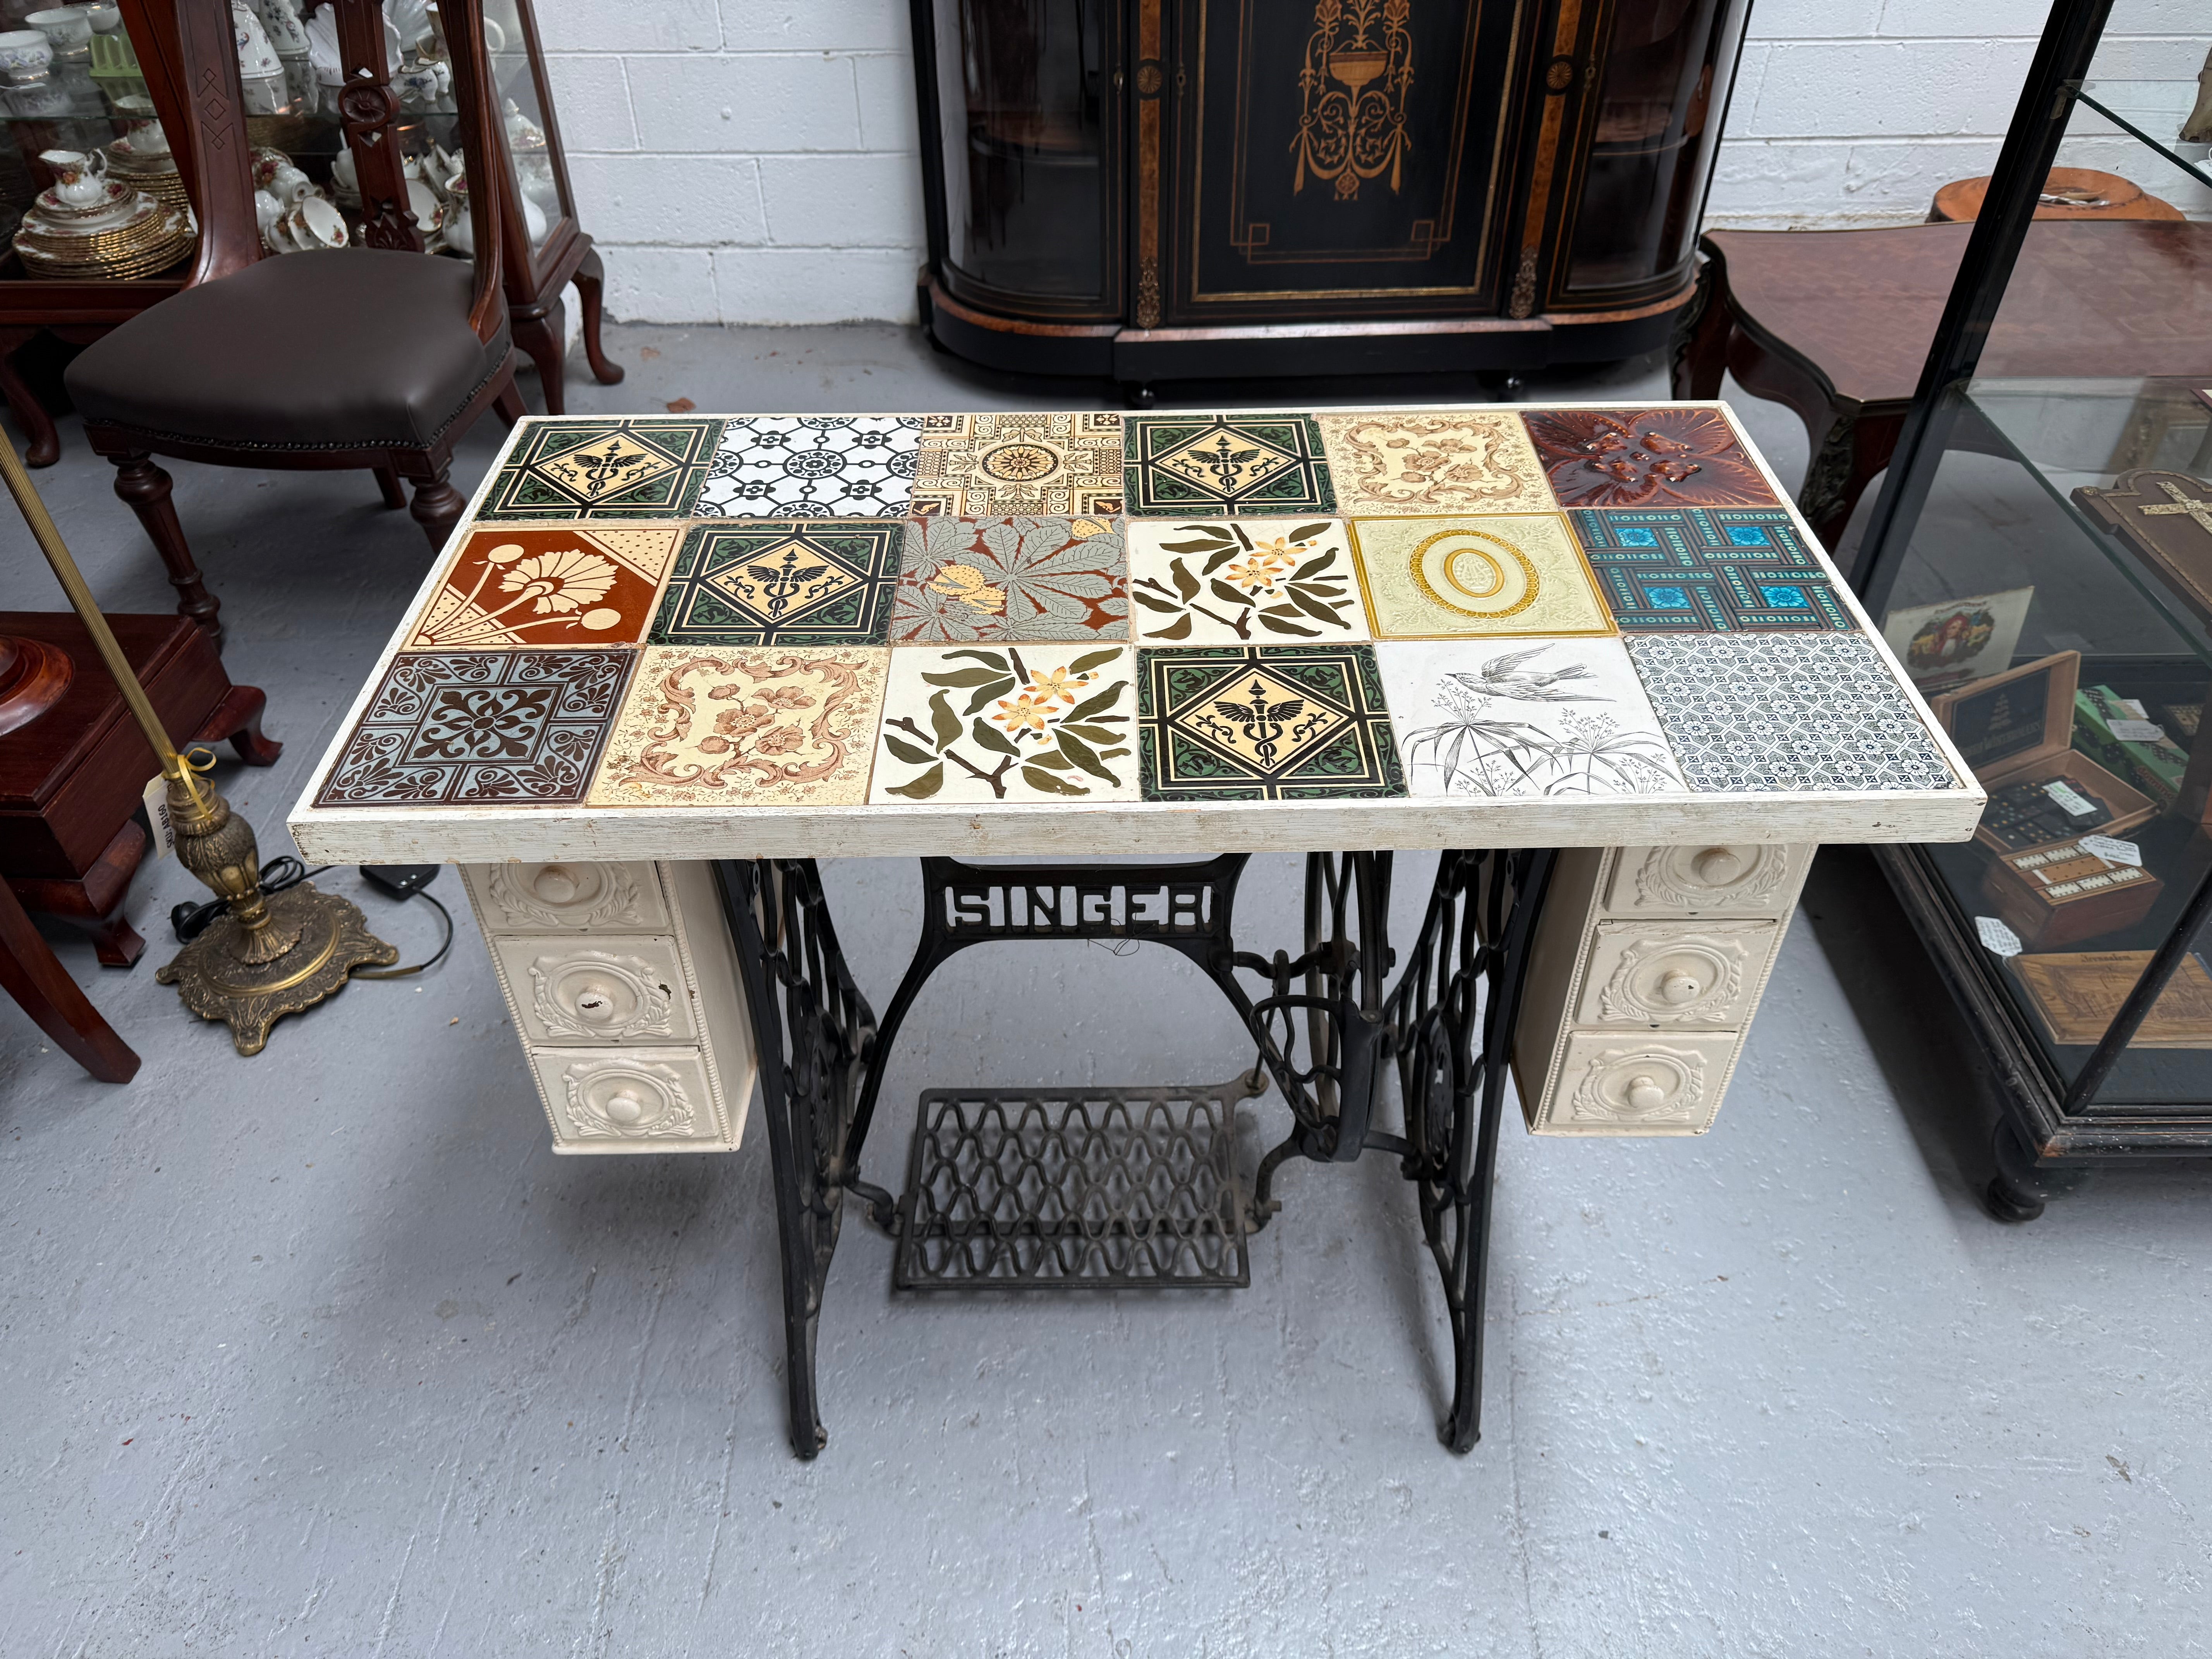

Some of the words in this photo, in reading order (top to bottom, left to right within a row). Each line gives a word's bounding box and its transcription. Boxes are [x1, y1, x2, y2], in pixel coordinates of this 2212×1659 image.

[158, 804, 170, 830] AB160
[165, 828, 175, 848] SKU:
[951, 886, 1205, 928] SINGER
